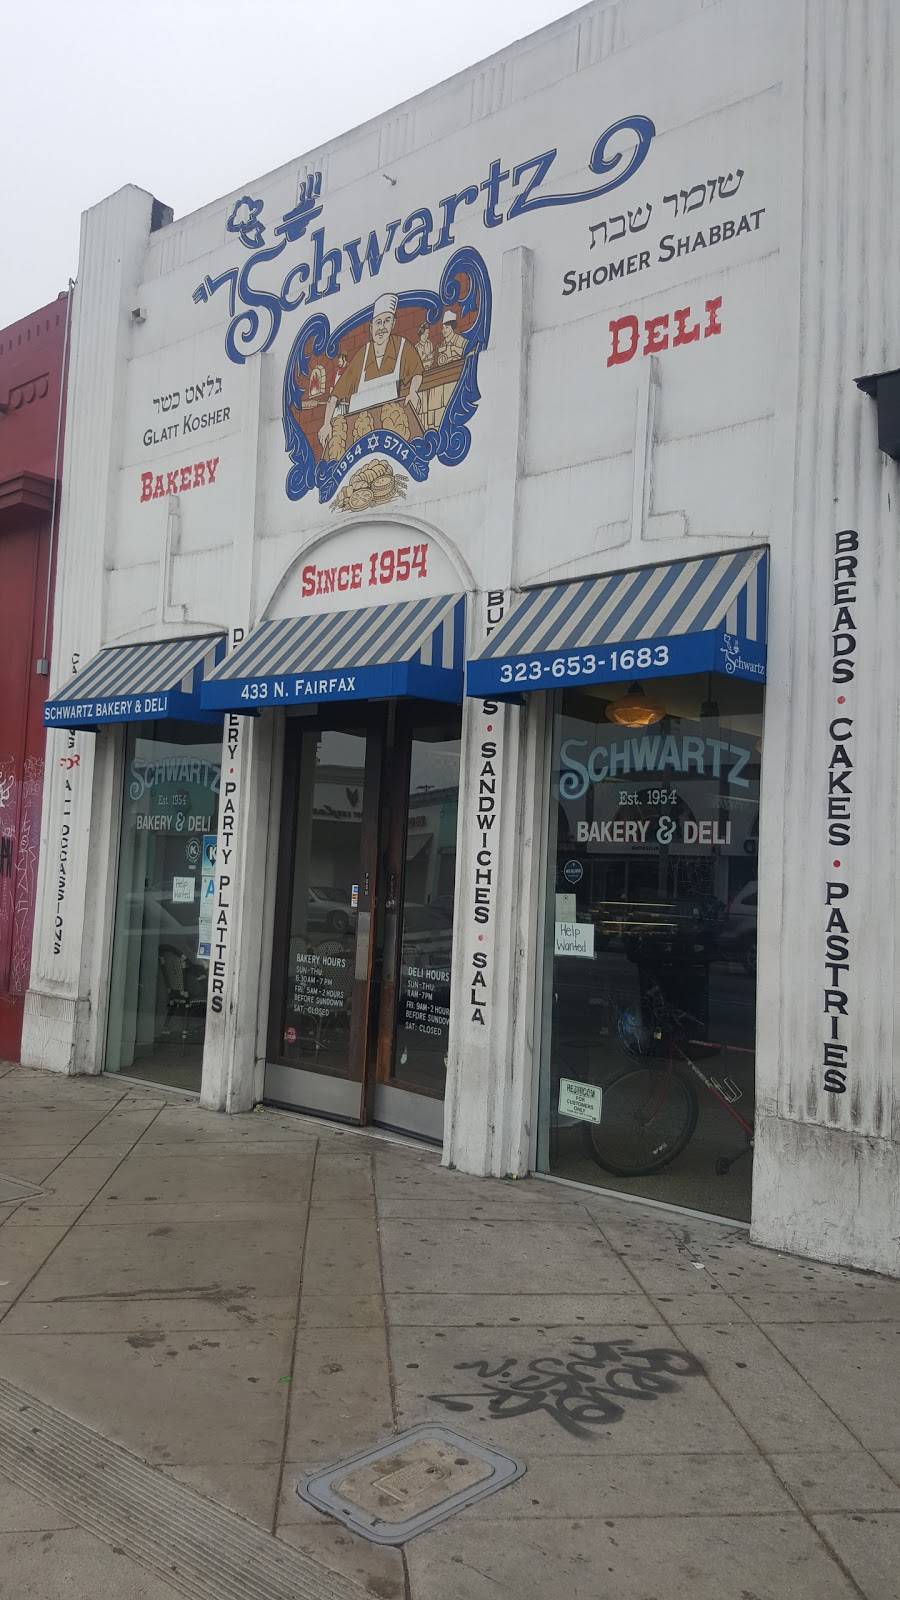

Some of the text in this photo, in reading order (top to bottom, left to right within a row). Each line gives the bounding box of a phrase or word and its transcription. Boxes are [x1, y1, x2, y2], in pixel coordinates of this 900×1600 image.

[588, 168, 745, 250] שומר שבת
[561, 208, 766, 296] SHOMER SHABBAT
[606, 295, 723, 368] DELI
[143, 407, 231, 447] GLATT KOSHER
[336, 435, 410, 477] 1954 5714
[140, 456, 220, 503] BAKERY
[301, 543, 428, 598] SINCE 1954
[831, 530, 858, 684] BREADS
[499, 645, 670, 684] 323-653-1683
[720, 649, 765, 675] Schwartz
[43, 695, 169, 721] SCHWARTZ BAKERY & DELI
[240, 676, 356, 701] 433 N. FAIRFAX
[129, 757, 221, 801] SCHWARTZ
[559, 735, 751, 800] SCHWARTZ
[827, 716, 853, 846] CAKES
[618, 788, 678, 807] Est. 1954
[136, 811, 211, 833] BAKERY & DELI
[474, 740, 497, 925] SANDWICHES
[577, 815, 732, 846] BAKERY & DELI
[211, 781, 237, 1013] PARTY PLATTERS
[556, 938, 587, 953] Wanted
[560, 923, 581, 940] Help
[296, 953, 346, 968] BAKERY HOURS
[408, 966, 450, 982] DELI HOURS
[823, 881, 849, 1093] PASTRIES
[405, 1010, 426, 1021] BEFORE
[419, 1024, 442, 1036] CLOSED
[434, 1005, 450, 1016] HOUR
